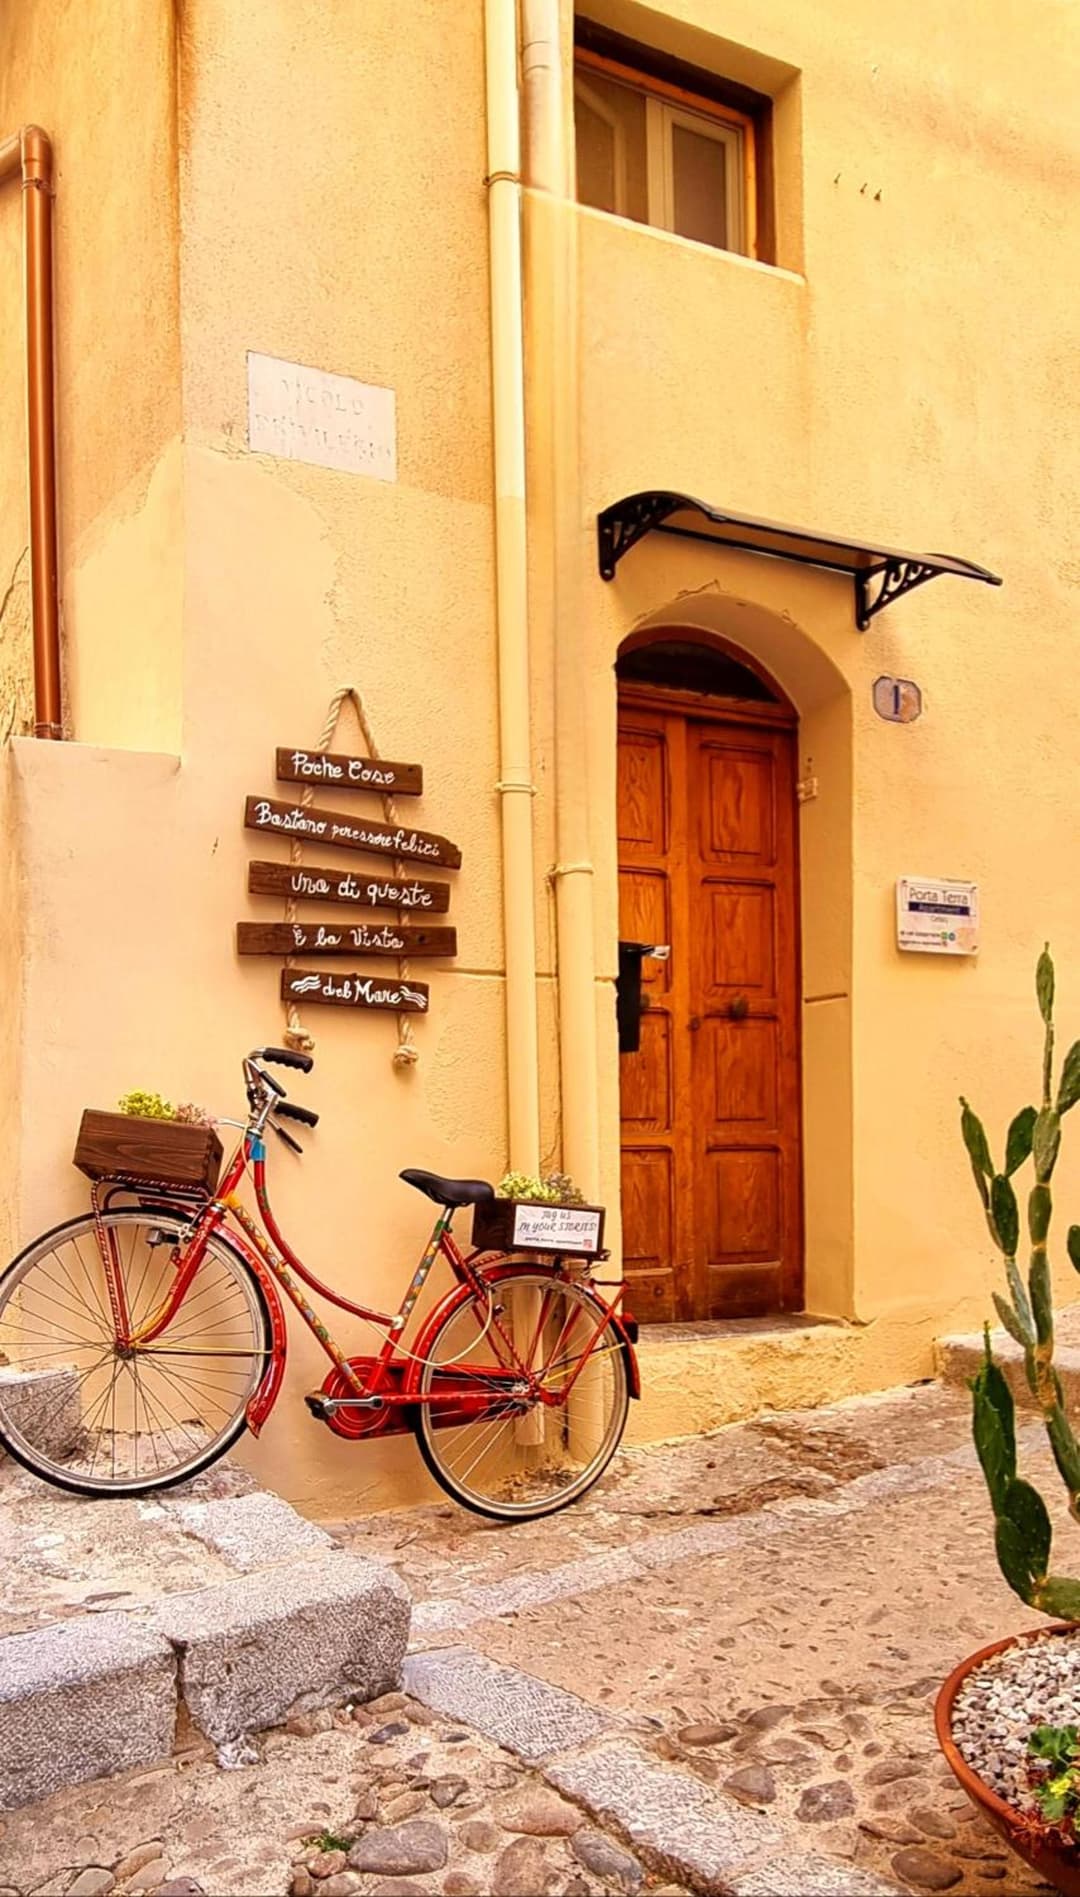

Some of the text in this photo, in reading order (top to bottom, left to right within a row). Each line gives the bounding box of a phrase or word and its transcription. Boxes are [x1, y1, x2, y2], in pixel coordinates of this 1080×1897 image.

[291, 751, 396, 785] Poche Cose
[253, 801, 328, 834] Bastano
[337, 874, 361, 899] di
[367, 881, 433, 906] queste
[909, 886, 969, 905] Porta Terra
[314, 926, 342, 947] la
[349, 923, 405, 949] Vista
[322, 975, 402, 1004] del Mare
